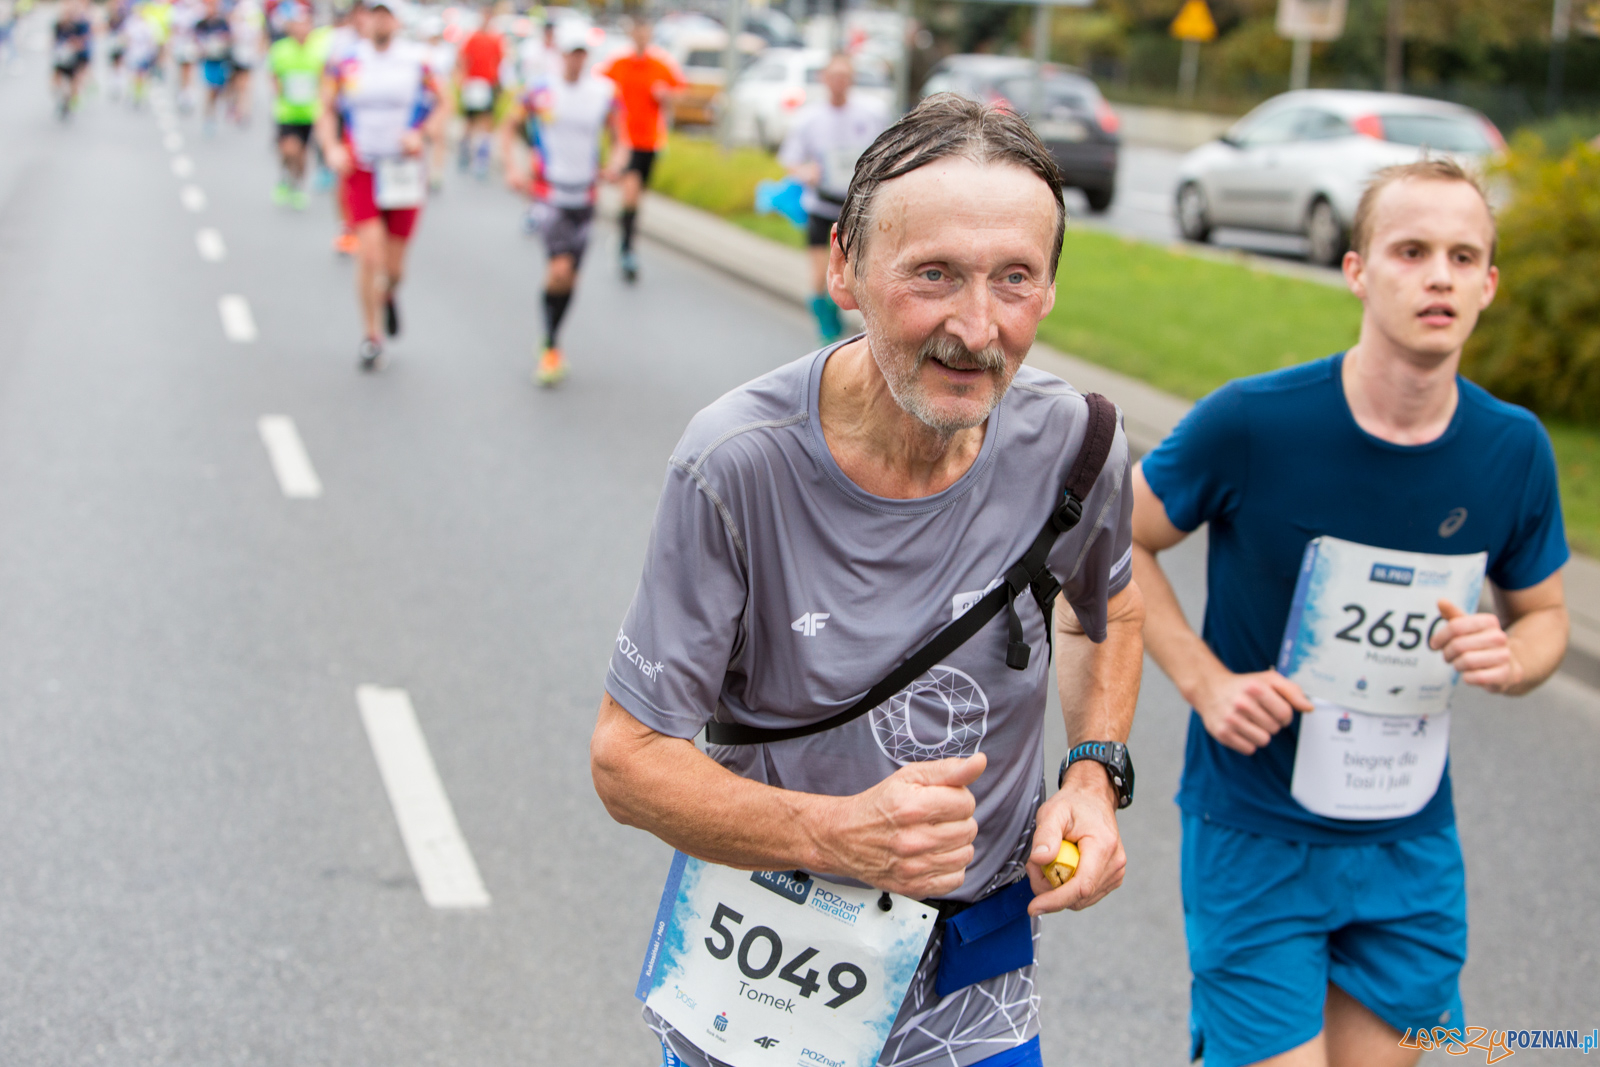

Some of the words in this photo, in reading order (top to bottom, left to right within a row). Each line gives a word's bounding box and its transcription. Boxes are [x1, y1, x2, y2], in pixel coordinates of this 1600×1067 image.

[790, 611, 831, 637] 4F
[776, 873, 806, 895] PKO
[811, 897, 858, 923] maraton
[704, 901, 868, 1010] 5049
[739, 980, 797, 1014] Tomek
[753, 1035, 781, 1050] 4F
